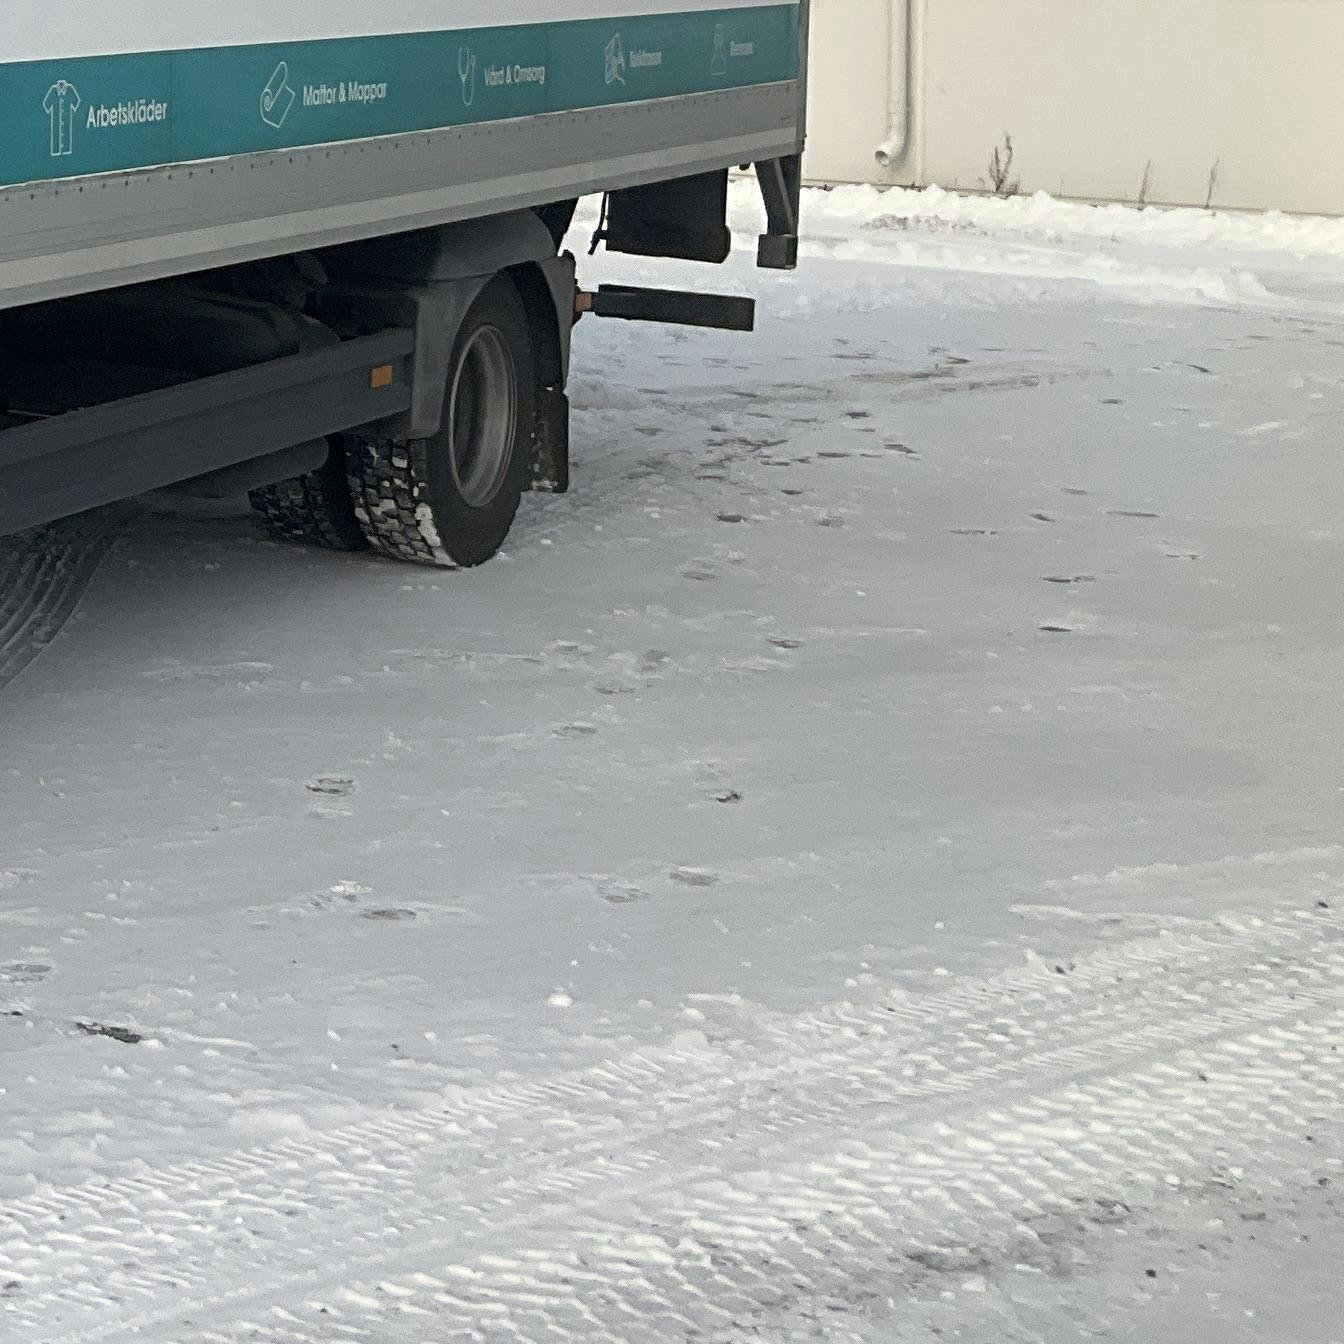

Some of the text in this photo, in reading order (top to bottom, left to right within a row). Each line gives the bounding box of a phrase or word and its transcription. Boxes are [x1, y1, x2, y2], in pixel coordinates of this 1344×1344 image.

[303, 81, 387, 107] Mattor & Moppar
[86, 99, 168, 129] Arbetskläder
